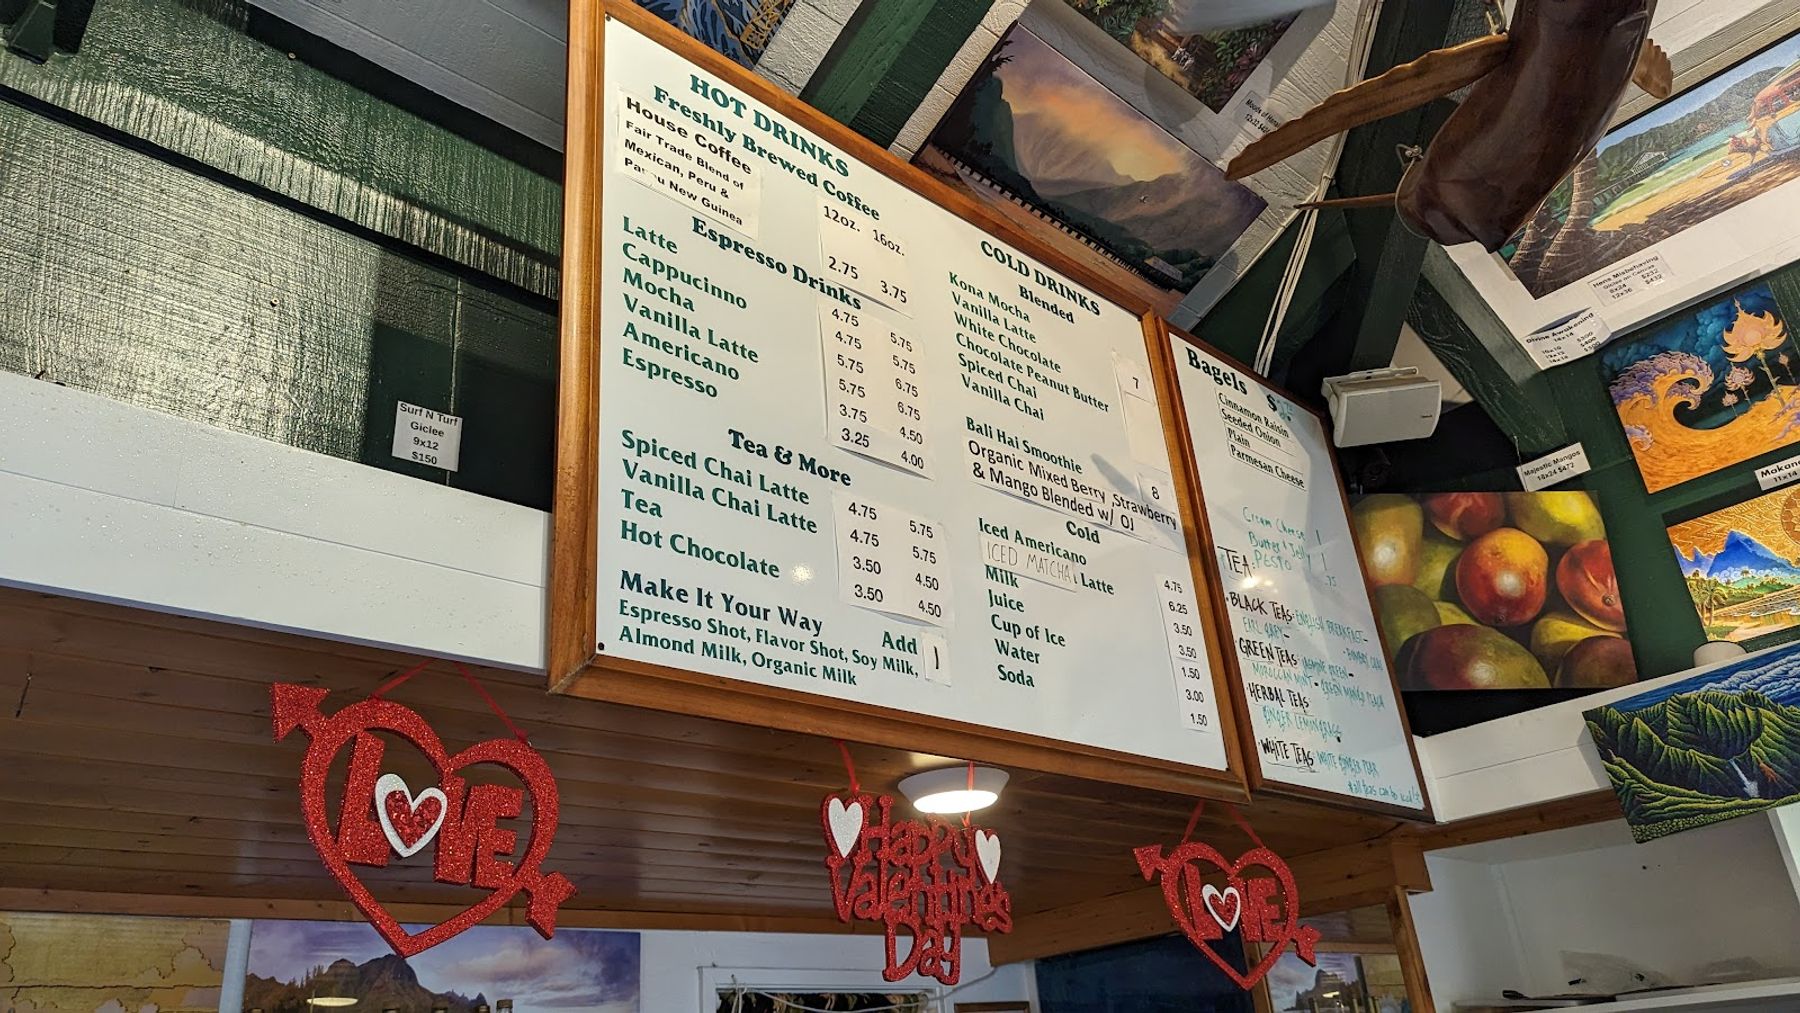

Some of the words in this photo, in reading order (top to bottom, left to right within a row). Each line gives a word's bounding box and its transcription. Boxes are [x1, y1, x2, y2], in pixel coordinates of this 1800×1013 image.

[627, 97, 688, 138] House
[694, 130, 752, 175] Coffee
[690, 74, 747, 118] HOT
[753, 109, 849, 177] DRINKS
[624, 139, 684, 178] Mexican,
[688, 171, 716, 192] Peru
[721, 187, 730, 199] &
[626, 120, 651, 141] Fair
[656, 136, 692, 161] Trade
[697, 156, 729, 182] Blend
[733, 179, 744, 190] of
[653, 85, 737, 143] Freshly
[743, 133, 818, 187] Brewed
[823, 180, 880, 221] Coffee
[669, 180, 698, 202] New
[701, 197, 743, 226] Guinea
[623, 216, 678, 254] Latte
[823, 206, 861, 232] 12oz.
[872, 228, 905, 256] 16oz.
[622, 241, 748, 309] Cappucinno
[692, 216, 787, 274] Espresso
[792, 264, 863, 310] Drinks
[828, 256, 859, 280] 2.75
[880, 279, 908, 304] 3.75
[980, 240, 1030, 277] COLD
[1034, 269, 1101, 316] DRINKS
[624, 267, 695, 311] Mocha
[949, 271, 984, 300] Kona
[988, 292, 1031, 323] Mocha
[1018, 284, 1075, 324] Blended
[623, 293, 701, 340] Vanilla
[707, 328, 759, 363] Latte
[831, 308, 859, 327] 4.75
[889, 332, 912, 352] 5.75
[952, 291, 1000, 326] Vanilla
[1004, 318, 1036, 344] Latte
[622, 321, 740, 380] Americano
[835, 330, 863, 350] 4.75
[892, 355, 916, 375] 5.75
[954, 312, 995, 342] White
[998, 334, 1062, 373] Chocolate
[623, 347, 718, 398] Espresso
[837, 354, 864, 374] 5.75
[895, 378, 919, 398] 6.75
[955, 333, 1024, 373] Chocolate
[1027, 365, 1070, 395] Peanut
[1072, 387, 1109, 413] Butter
[958, 353, 1003, 384] Spiced
[1008, 376, 1038, 399] Chai
[1132, 377, 1140, 389] 7
[1186, 347, 1248, 395] Bagels
[400, 403, 422, 416] Surf
[426, 411, 433, 419] N
[437, 413, 458, 426] Turf
[838, 378, 866, 399] 5.75
[897, 401, 921, 421] 6.75
[961, 373, 1010, 407] Vanilla
[1015, 396, 1045, 421] Chai
[1218, 393, 1263, 425] Cinnamon
[1263, 416, 1289, 438] Raisin
[410, 421, 444, 437] Giclee
[413, 436, 439, 450] 9x12
[839, 403, 868, 424] 3.75
[899, 426, 923, 445] 4.50
[966, 416, 994, 439] Bali
[997, 426, 1020, 449] Hai
[1023, 440, 1083, 475] Smoothie
[1221, 408, 1253, 433] Seeded
[1255, 427, 1281, 447] Onion
[1227, 428, 1250, 447] Plain
[412, 451, 437, 465] $150
[622, 429, 697, 470] Spiced
[704, 456, 753, 488] Chai
[759, 474, 810, 505] Latte
[728, 428, 768, 458] Tea
[774, 446, 793, 465] &
[799, 453, 851, 487] More
[841, 428, 871, 448] 3.25
[900, 450, 925, 469] 4.00
[1230, 444, 1273, 473] Parmesan
[1275, 465, 1305, 488] Cheese
[1524, 462, 1552, 477] Majestic
[1553, 450, 1580, 465] Mangos
[968, 439, 1024, 471] Organic
[1028, 461, 1068, 490] Mixed
[1071, 479, 1106, 504] Berry
[1151, 486, 1160, 500] 8
[621, 488, 663, 519] Tea
[622, 458, 705, 500] Vanilla
[712, 487, 760, 516] Chai
[767, 504, 818, 534] Latte
[972, 462, 986, 479] &
[990, 467, 1038, 498] Mango
[1042, 484, 1094, 517] Blended
[1098, 509, 1114, 526] w/
[1121, 515, 1134, 532] OJ
[848, 501, 878, 521] 4.75
[909, 520, 934, 539] 5.75
[978, 517, 1009, 541] Iced
[1014, 526, 1087, 566] Americano
[1066, 521, 1101, 545] Cold
[620, 519, 663, 549] Hot
[669, 534, 780, 579] Chocolate
[849, 528, 880, 548] 4.75
[912, 545, 937, 564] 5.75
[987, 541, 1018, 566] ICED
[853, 555, 882, 575] 3.50
[915, 572, 939, 591] 4.50
[985, 566, 1020, 589] Milk
[1081, 573, 1115, 596] Latte
[1164, 580, 1183, 594] 4.75
[620, 569, 689, 604] Make
[696, 587, 714, 608] It
[721, 592, 771, 622] Your
[777, 606, 823, 638] Way
[854, 583, 884, 602] 3.50
[918, 599, 942, 618] 4.50
[988, 589, 1025, 613] Juice
[1169, 601, 1188, 615] 6.25
[1229, 591, 1268, 615] BLACK
[619, 599, 702, 631] Espresso
[707, 616, 751, 643] Shot,
[755, 629, 805, 652] Flavor
[810, 639, 848, 663] Shot,
[852, 649, 877, 671] Soy
[882, 656, 919, 678] Milk,
[881, 630, 918, 655] Add
[991, 614, 1021, 637] Cup
[1024, 625, 1040, 641] of
[1045, 629, 1066, 647] Ice
[994, 638, 1040, 664] Water
[1173, 622, 1193, 637] 3.50
[1239, 638, 1274, 661] GREEN
[619, 625, 695, 655] Almond
[701, 641, 747, 666] Milk,
[751, 652, 817, 679] Organic
[822, 664, 857, 686] Milk
[1179, 645, 1197, 659] 3.50
[1181, 666, 1200, 680] 1.50
[997, 664, 1035, 688] Soda
[1186, 689, 1204, 703] 3.00
[1248, 683, 1285, 707] HERBAL
[1191, 713, 1208, 726] 1.50
[1260, 737, 1289, 760] WHITE
[858, 795, 975, 882] Happy
[882, 912, 961, 986] Day
